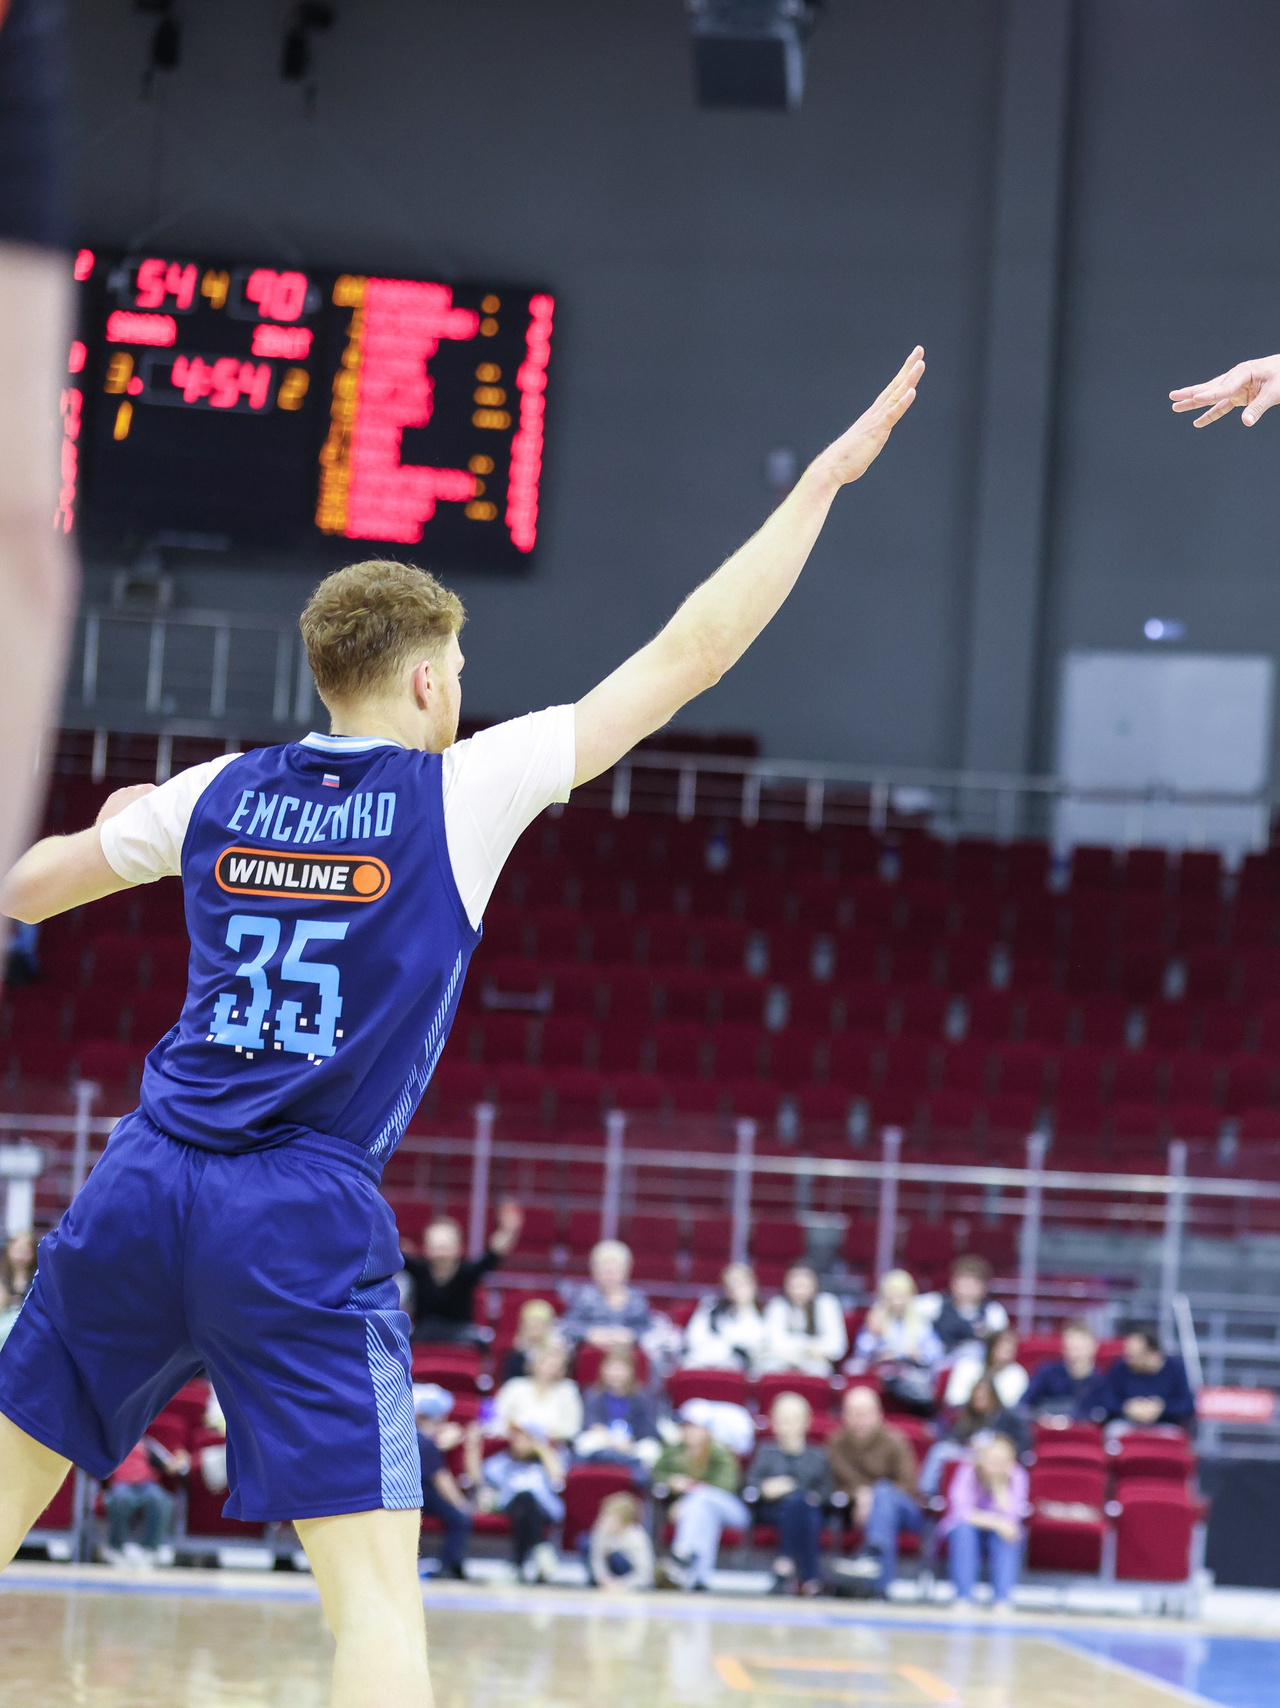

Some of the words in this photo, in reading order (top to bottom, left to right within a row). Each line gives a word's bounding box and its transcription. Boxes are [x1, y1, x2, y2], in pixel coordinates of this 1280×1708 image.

[135, 258, 198, 309] 54
[246, 268, 308, 321] 90
[229, 857, 351, 890] WINLINE
[209, 914, 351, 1058] 35
